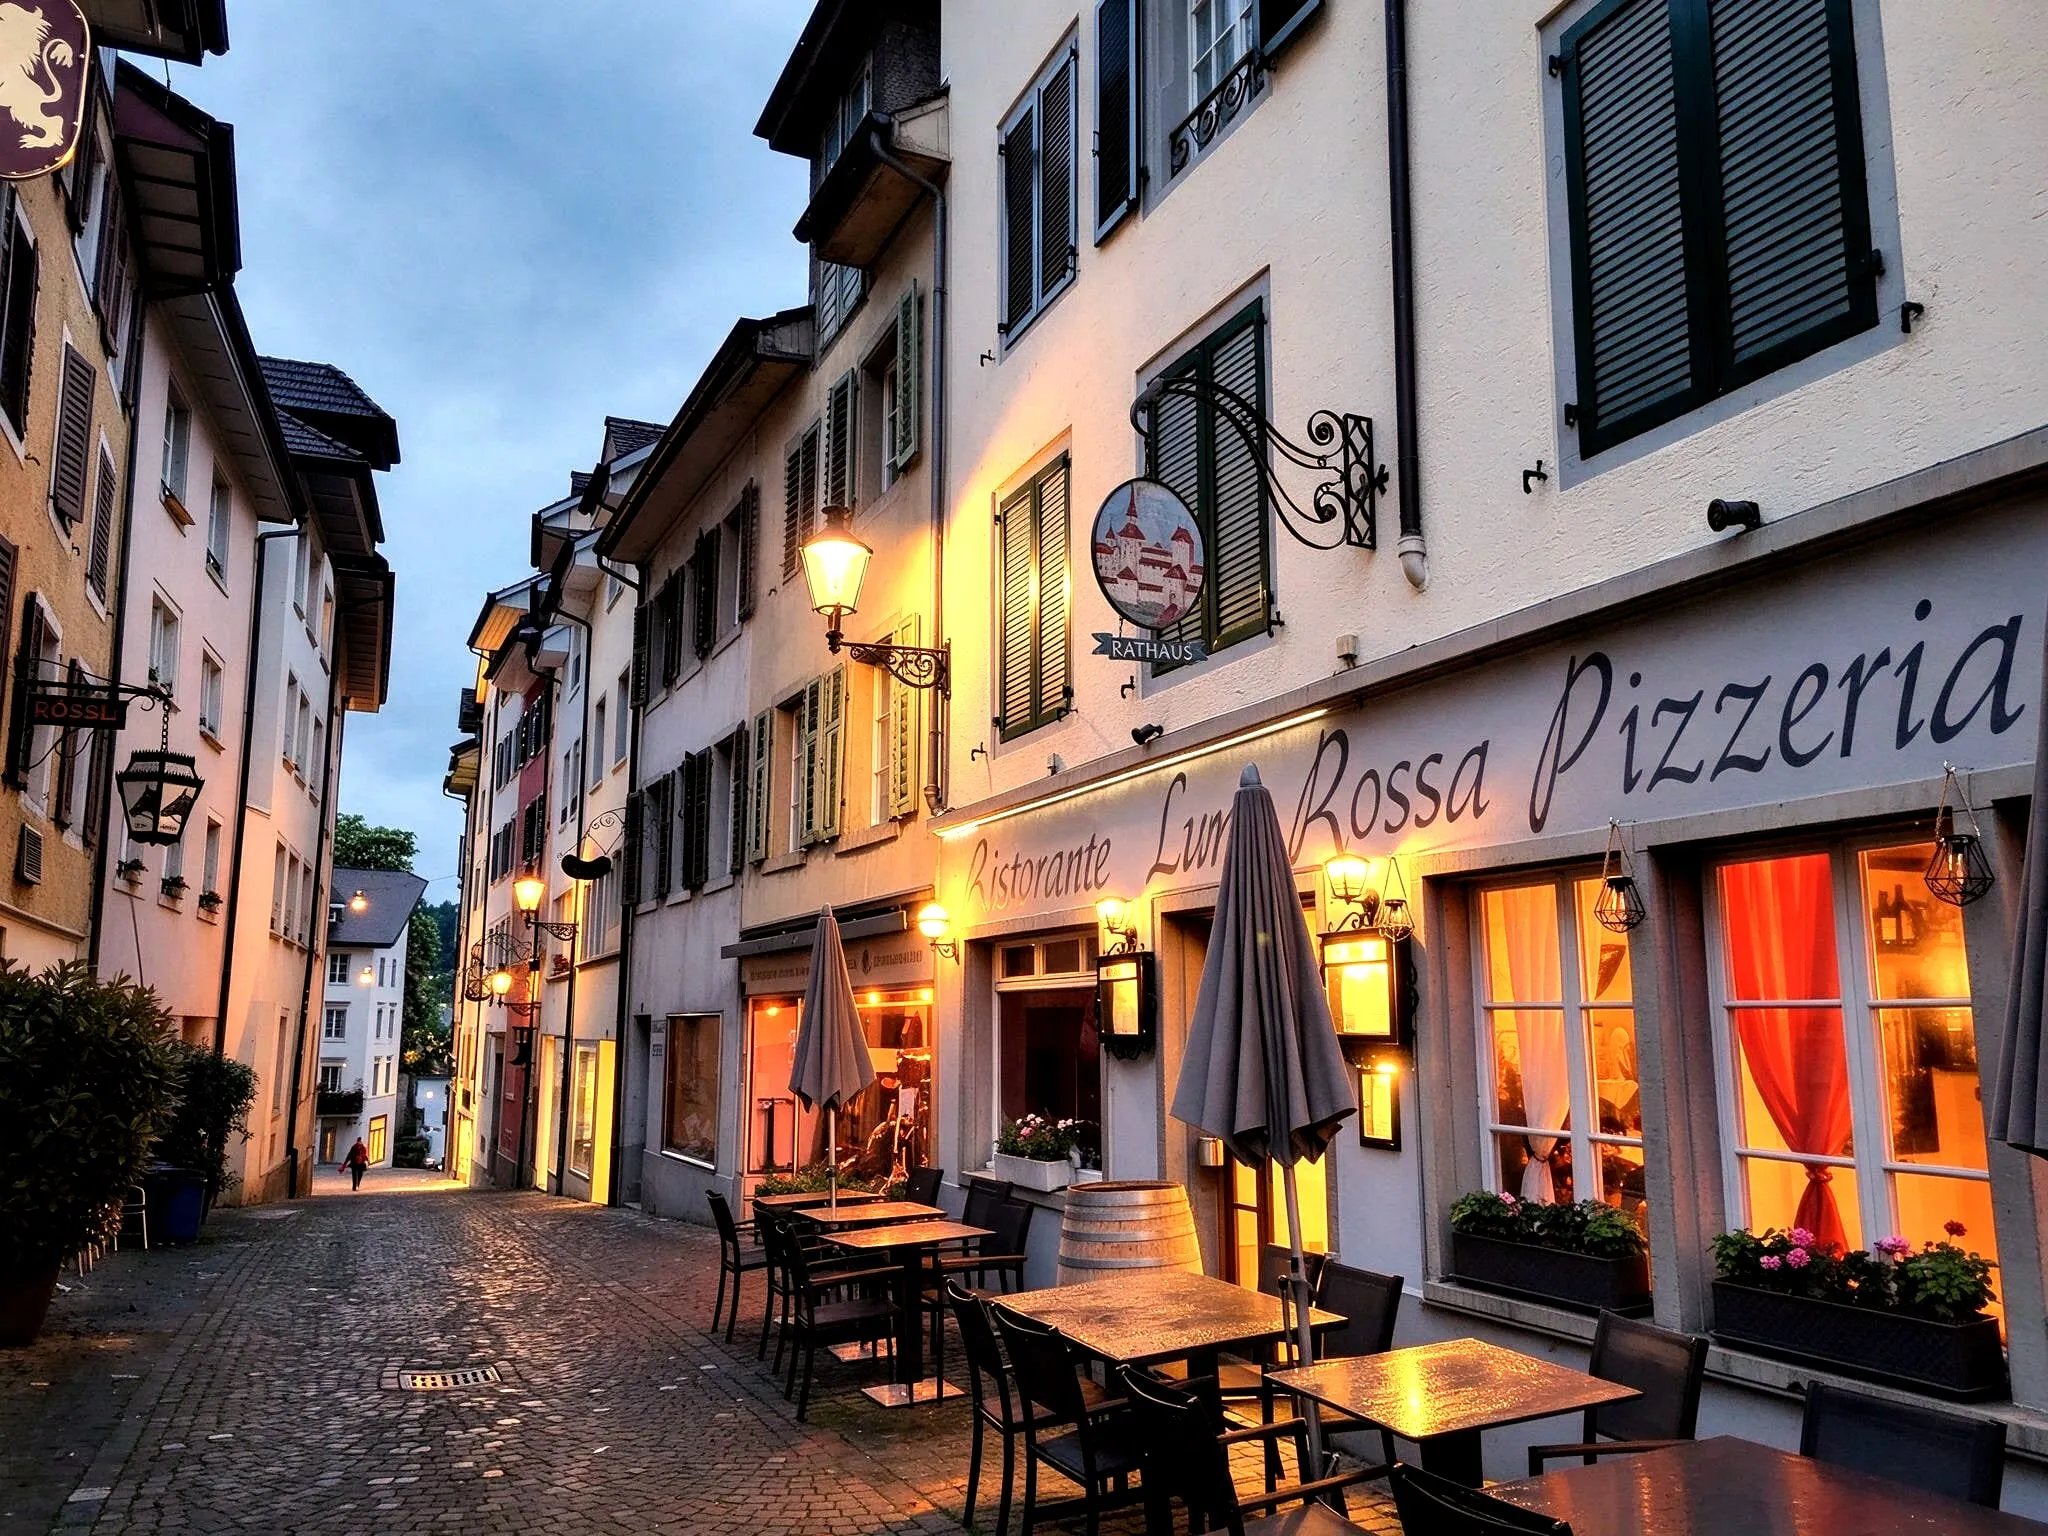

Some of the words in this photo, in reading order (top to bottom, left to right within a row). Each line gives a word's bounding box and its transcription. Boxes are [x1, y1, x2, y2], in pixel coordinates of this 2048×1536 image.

[1112, 640, 1193, 660] RATHAUS
[966, 832, 1111, 913] Ristorante
[1146, 772, 1234, 885] Lun
[1288, 728, 1490, 865] Rossa
[1529, 599, 2026, 833] Pizzeria
